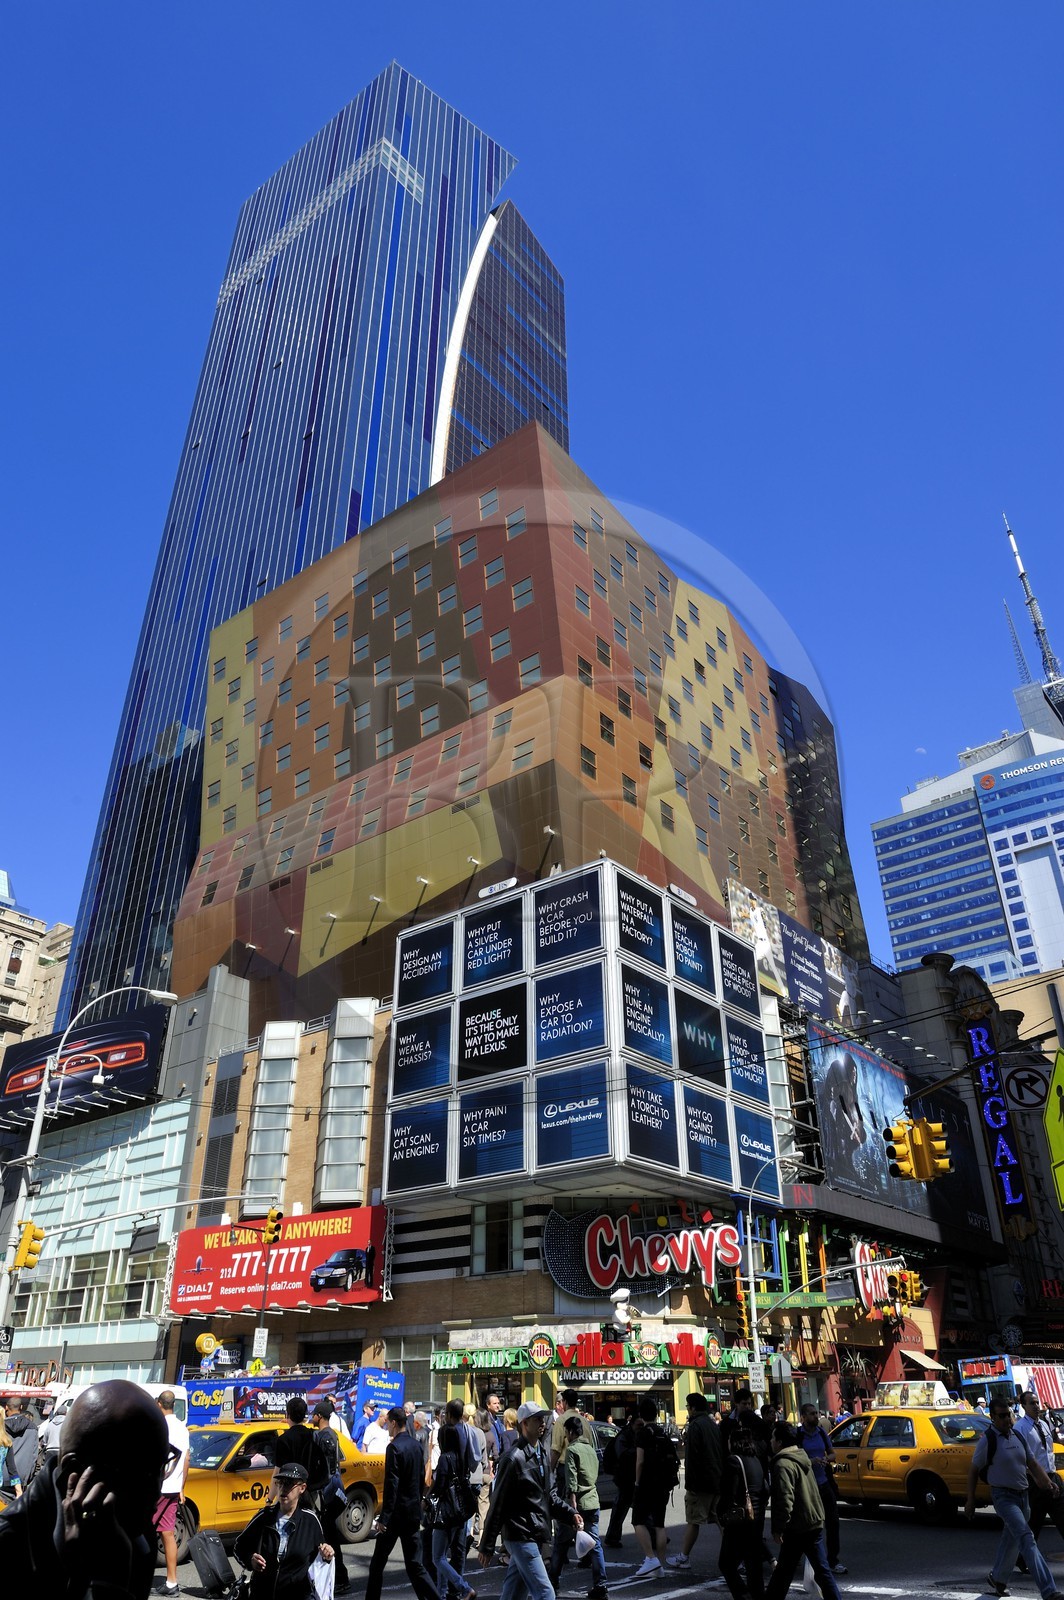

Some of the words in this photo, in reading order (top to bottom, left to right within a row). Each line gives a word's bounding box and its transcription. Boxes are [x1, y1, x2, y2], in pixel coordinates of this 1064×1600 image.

[1000, 762, 1048, 780] THOMSON
[538, 901, 559, 915] WHY
[560, 891, 589, 908] CRASH
[620, 890, 635, 906] WHY
[636, 900, 648, 912] PUT
[649, 906, 654, 916] A
[539, 916, 545, 925] A
[546, 910, 564, 924] CAR
[620, 900, 654, 926] WATERFALL
[622, 913, 628, 923] IN
[630, 918, 634, 926] A
[468, 926, 485, 938] WHY
[486, 920, 502, 932] PUT
[540, 918, 572, 936] BEFORE
[573, 912, 593, 925] YOU
[674, 920, 687, 934] WHY
[468, 940, 474, 949] A
[474, 932, 498, 948] SILVER
[540, 932, 564, 948] BUILD
[566, 928, 578, 940] IT?
[622, 924, 654, 946] FACTORY?
[674, 932, 692, 946] TEACH
[694, 942, 698, 951] A
[402, 948, 420, 960] WHY
[468, 948, 484, 960] CAR
[486, 938, 513, 954] UNDER
[676, 942, 695, 959] ROBOT
[720, 947, 734, 960] WHY
[402, 958, 430, 971] DESIGN
[431, 951, 442, 962] AN
[468, 958, 482, 970] RED
[484, 949, 511, 966] LIGHT?
[676, 952, 684, 962] TO
[684, 956, 703, 973] PAINT?
[402, 961, 442, 981] ACCIDENT?
[722, 959, 738, 974] INSIST
[738, 967, 746, 977] ON
[746, 971, 751, 980] A
[723, 968, 742, 985] SINGLE
[742, 977, 756, 991] PIECE
[724, 978, 732, 989] OF
[732, 983, 752, 998] WOOD?
[540, 992, 560, 1006] WHY
[624, 983, 640, 997] WHY
[540, 1002, 574, 1018] EXPOSE
[576, 999, 583, 1008] A
[625, 994, 642, 1010] TUNE
[643, 1003, 653, 1016] AN
[465, 1008, 502, 1026] BECAUSE
[465, 1024, 480, 1036] IT'S
[480, 1022, 494, 1033] THE
[496, 1015, 518, 1030] ONLY
[540, 1016, 560, 1030] CAR
[562, 1013, 573, 1024] TO
[626, 1007, 651, 1026] ENGINE
[399, 1033, 416, 1045] WHY
[465, 1036, 482, 1048] WAY
[484, 1034, 495, 1044] TO
[496, 1026, 520, 1041] MAKE
[540, 1020, 593, 1042] RADIATION?
[626, 1019, 664, 1043] MUSICALLY?
[684, 1022, 716, 1050] WHY
[728, 1032, 742, 1045] WHY
[742, 1038, 748, 1048] IS
[398, 1043, 424, 1056] WEAVE
[425, 1040, 430, 1050] A
[464, 1048, 472, 1058] IT
[472, 1047, 479, 1057] A
[480, 1040, 507, 1056] LEXUS.
[398, 1051, 432, 1068] CHASSIS?
[750, 1054, 758, 1062] OF
[732, 1065, 744, 1078] TOO
[744, 1070, 762, 1085] MUCH?
[558, 1097, 600, 1114] LEXUS
[630, 1086, 646, 1098] WHY
[647, 1091, 662, 1106] TAKE
[464, 1110, 483, 1122] WHY
[484, 1106, 507, 1118] PAINT
[630, 1098, 637, 1108] A
[638, 1101, 660, 1117] TORCH
[660, 1109, 670, 1120] TO
[686, 1105, 701, 1119] WHY
[702, 1112, 712, 1123] GO
[967, 1026, 1024, 1205] REGAL
[464, 1125, 470, 1135] A
[471, 1121, 488, 1133] CAR
[542, 1110, 603, 1130] lexus.com/thehardway
[632, 1111, 662, 1130] LEATHER?
[688, 1119, 713, 1135] AGAINST
[393, 1137, 408, 1149] CAT
[409, 1132, 432, 1146] SCAN
[394, 1125, 412, 1138] WHY
[463, 1136, 476, 1148] SIX
[478, 1130, 506, 1144] TIMES?
[690, 1131, 717, 1148] GRAVITY?
[392, 1150, 404, 1161] AN
[405, 1142, 440, 1158] ENGINE?
[750, 1138, 772, 1152] LEXUS
[284, 1216, 352, 1241] ANYWHERE!
[204, 1230, 232, 1250] WE'LL
[235, 1228, 258, 1246] TAKE
[585, 1213, 742, 1289] Chevys
[220, 1268, 232, 1279] 212
[232, 1246, 312, 1278] 777-7777
[220, 1284, 245, 1295] Reserve
[270, 1281, 302, 1290] dial7.com
[530, 1344, 553, 1358] villa
[556, 1332, 624, 1368] villa
[640, 1346, 658, 1356] villa
[430, 1352, 458, 1370] PIZZA
[472, 1350, 511, 1368] SALADS
[564, 1371, 604, 1381] MARKET
[606, 1371, 634, 1380] FOOD
[638, 1371, 671, 1380] COURT
[232, 1491, 250, 1501] NYC
